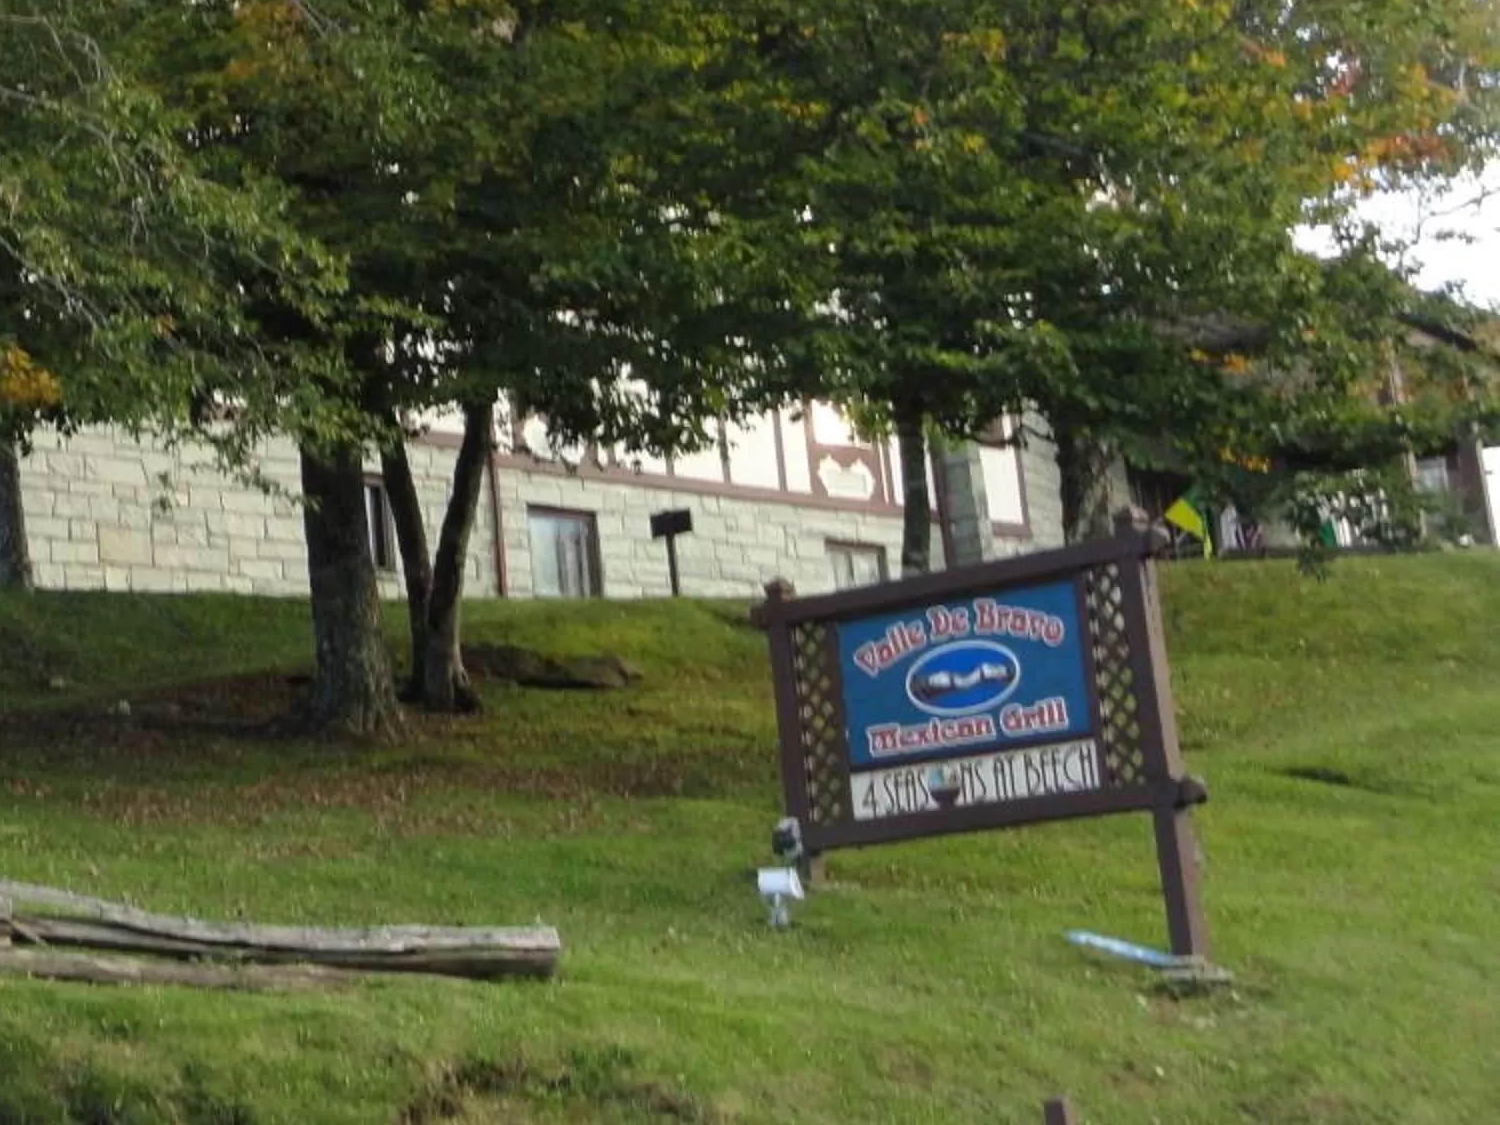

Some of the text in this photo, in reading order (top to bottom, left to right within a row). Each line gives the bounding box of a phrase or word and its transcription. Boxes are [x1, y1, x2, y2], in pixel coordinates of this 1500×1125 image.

[853, 598, 1064, 677] Valle De Bravo
[867, 696, 1068, 757] Mexican Grill
[862, 779, 878, 817] 4
[994, 755, 1016, 796] AT
[1023, 746, 1099, 794] BEECH
